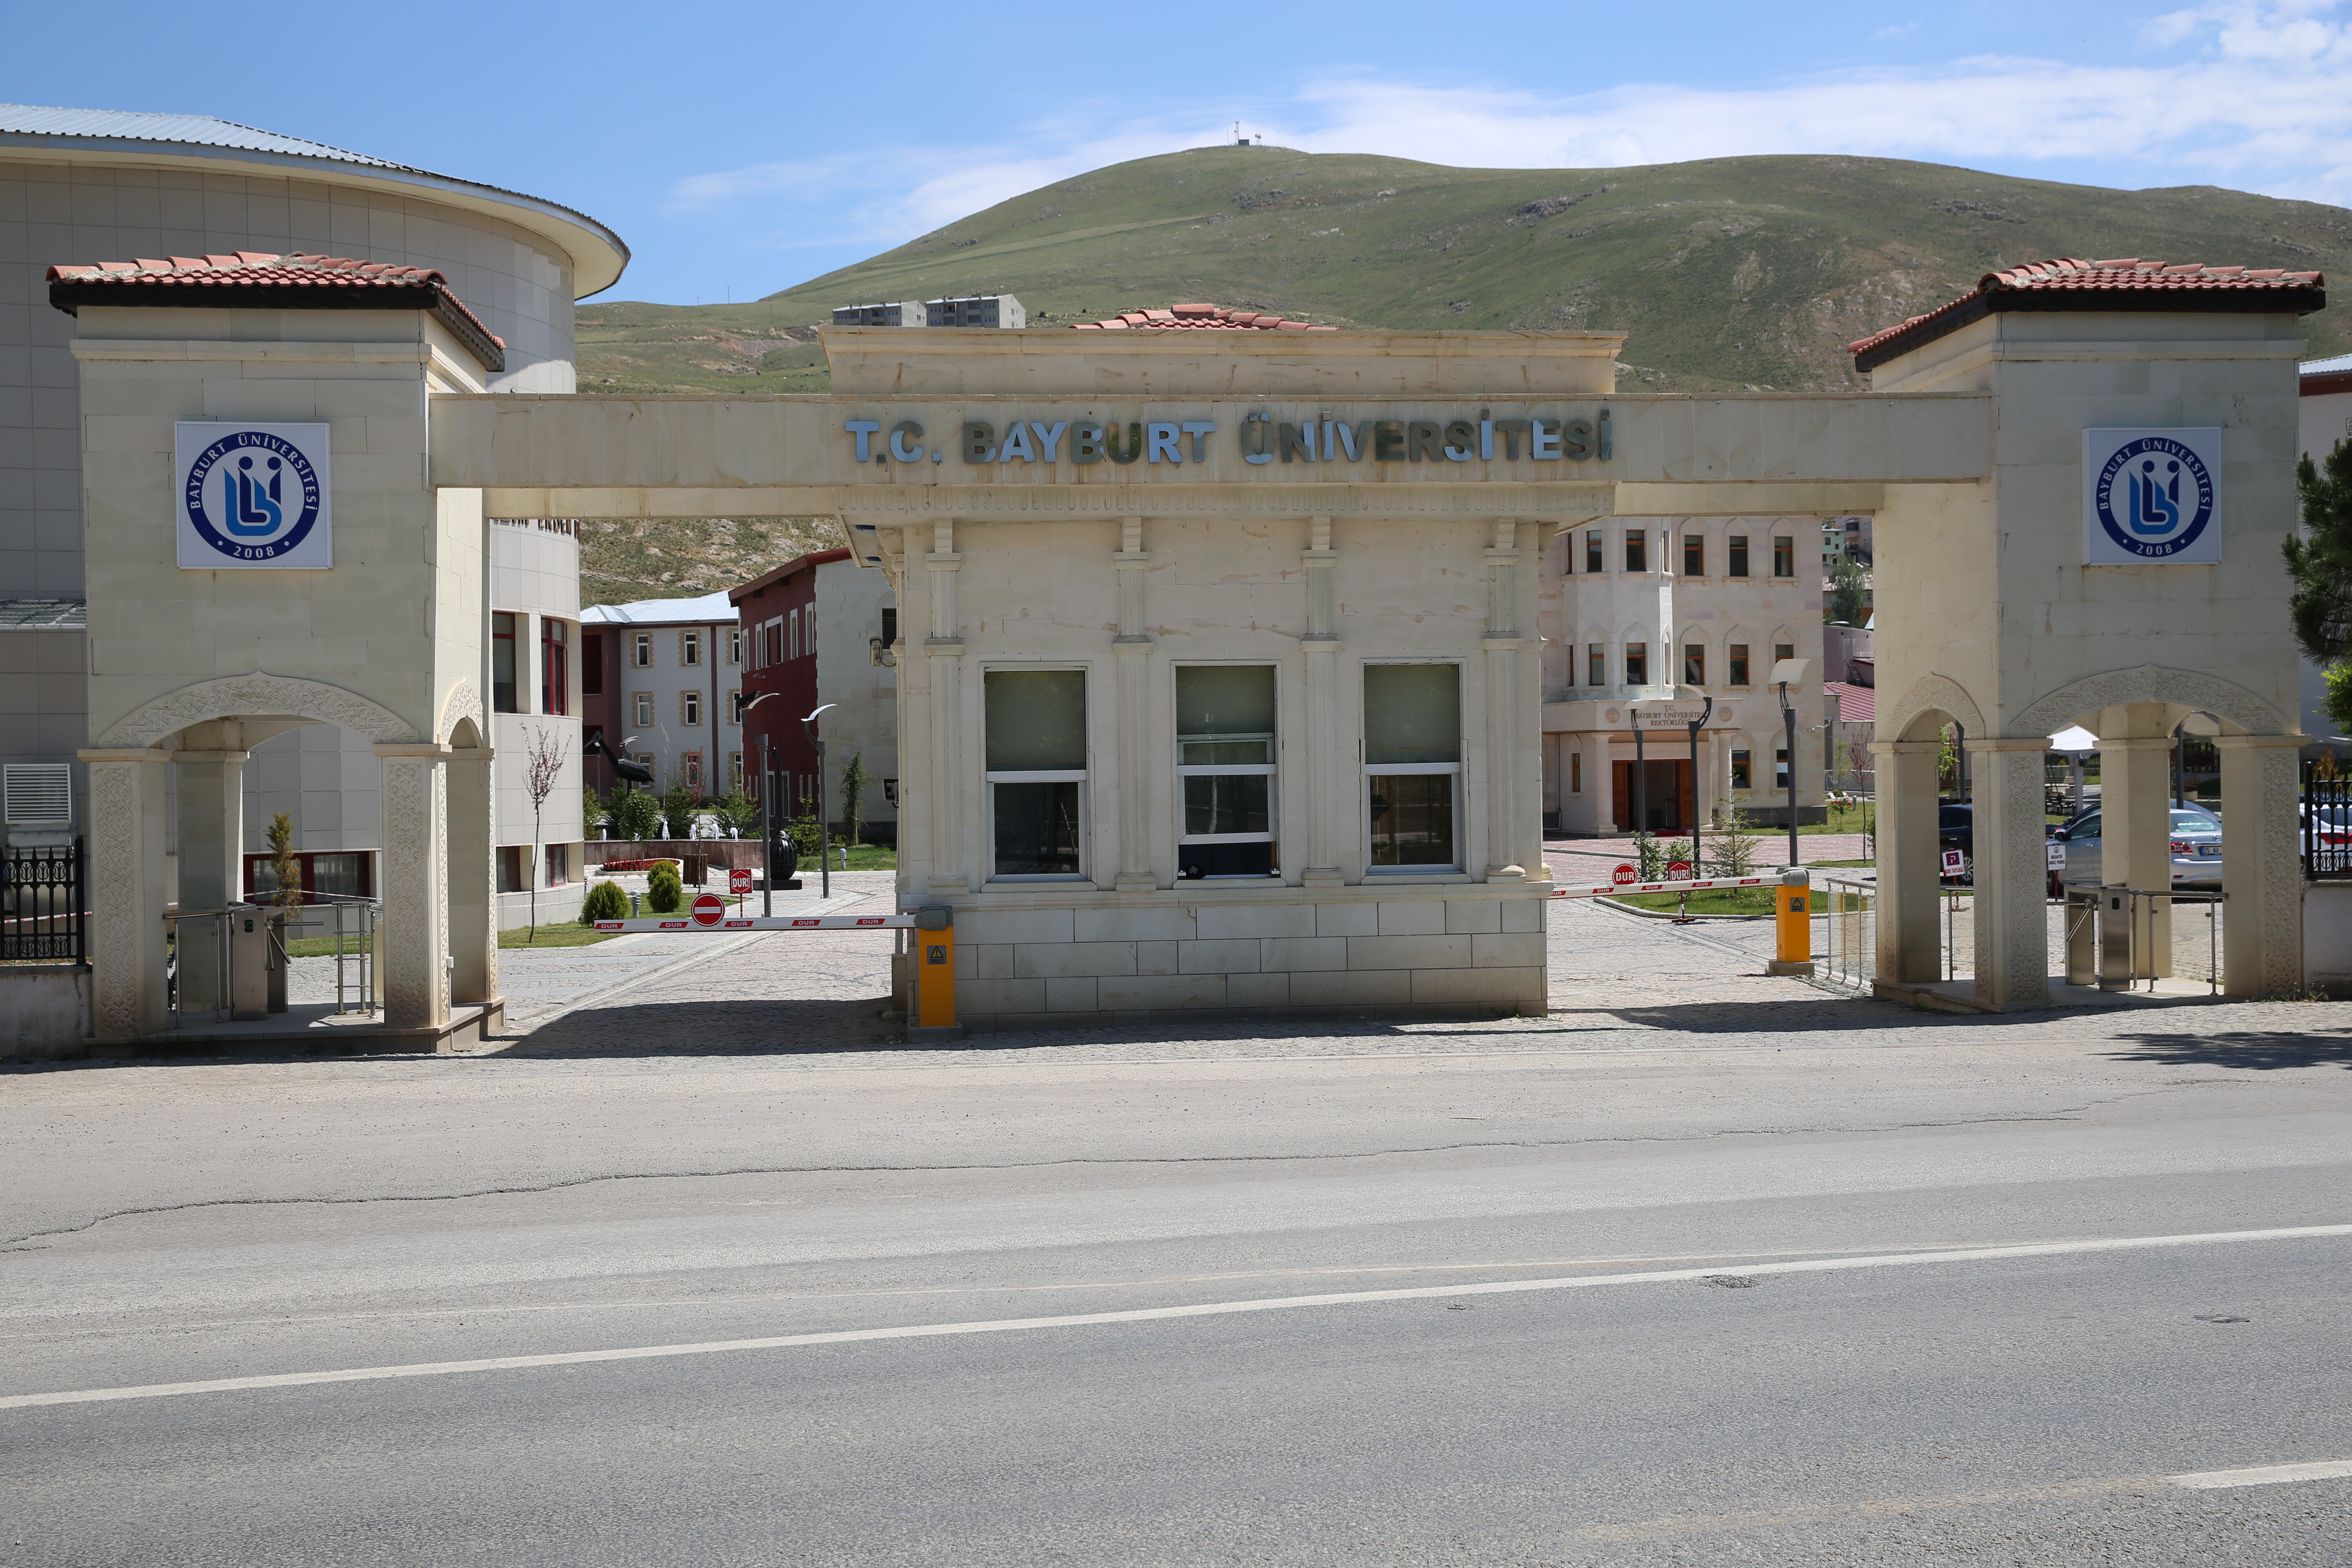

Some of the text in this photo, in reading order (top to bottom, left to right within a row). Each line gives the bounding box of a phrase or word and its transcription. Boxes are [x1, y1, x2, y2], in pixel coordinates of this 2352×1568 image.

[845, 409, 1613, 466] T.C. BAYBURT ÜNİVERSİTESİ
[189, 433, 318, 510] BAYBURT ÜNİVERSİTESİ
[2099, 439, 2211, 510] BAYBURT ÜNİVERSİTESİ
[233, 546, 274, 558] 2008
[2136, 543, 2172, 555] 2008
[1650, 718, 1692, 726] REKTÖRLÜĞ
[1616, 871, 1635, 882] DUR
[1671, 869, 1689, 880] DUR!
[732, 877, 749, 888] DUR!
